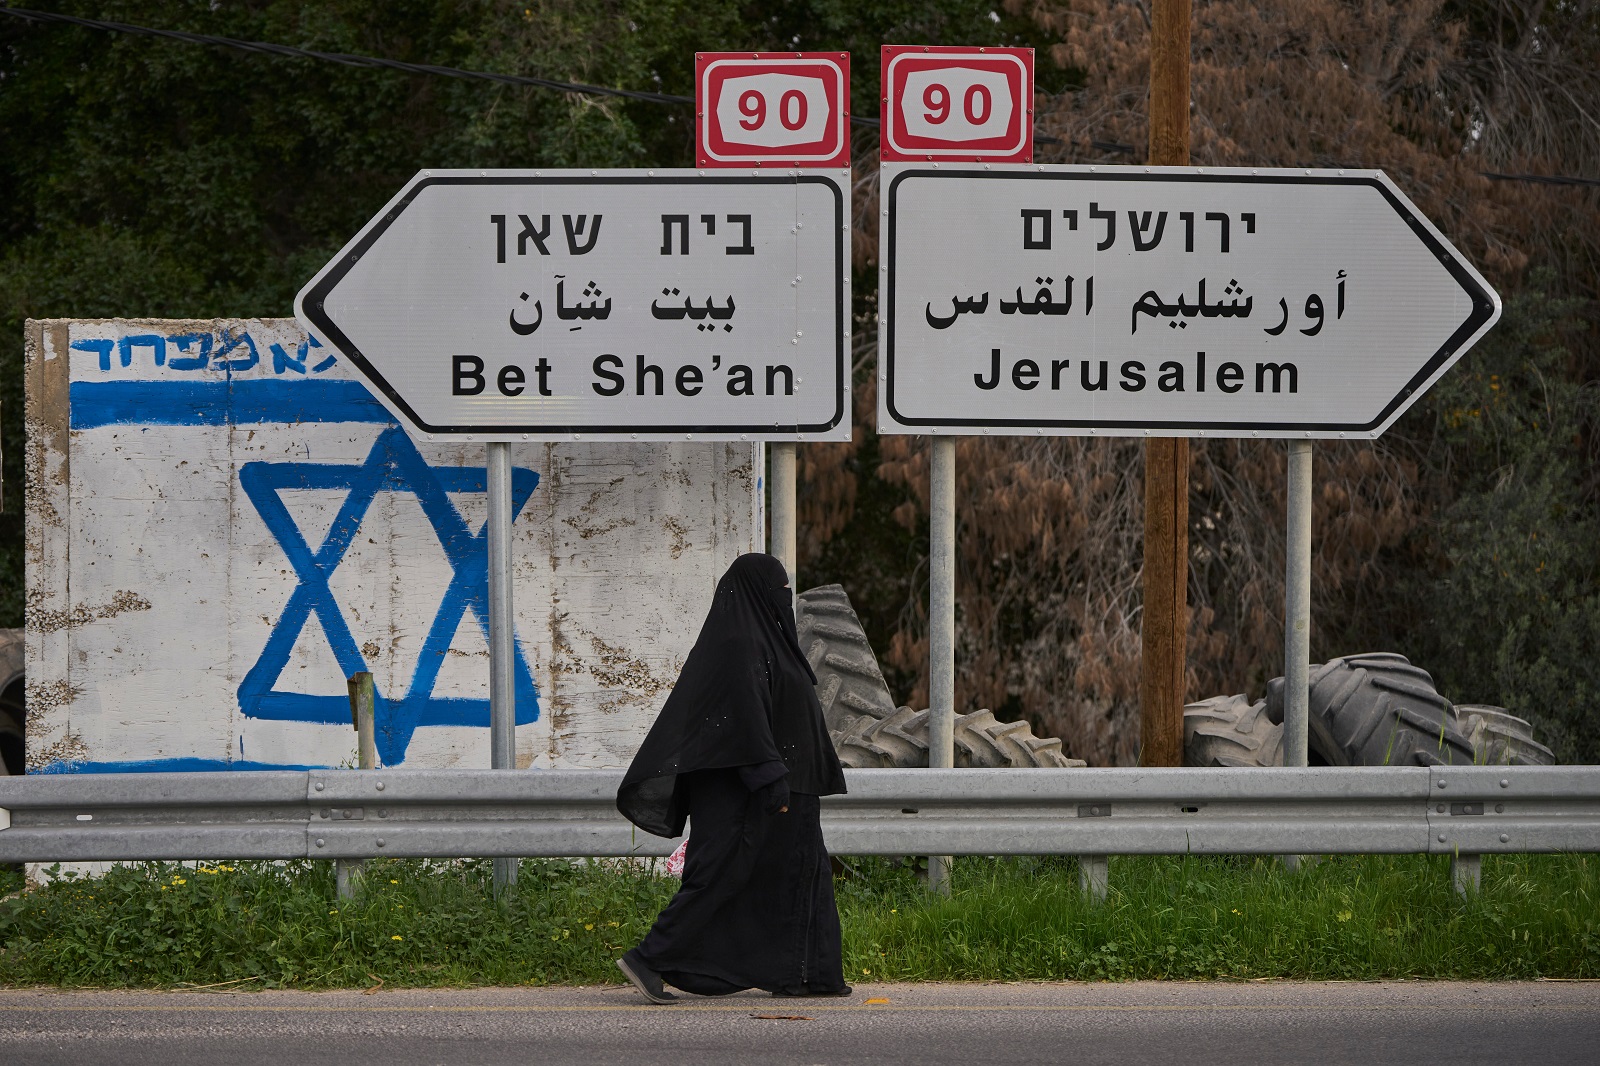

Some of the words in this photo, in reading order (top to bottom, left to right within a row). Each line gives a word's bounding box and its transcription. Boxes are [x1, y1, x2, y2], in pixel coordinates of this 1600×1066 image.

[737, 89, 809, 131] 90
[922, 83, 993, 126] 90
[490, 214, 603, 264] שאן
[660, 214, 755, 256] בית
[1020, 201, 1256, 254] ירושלים
[650, 287, 736, 333] بيت
[925, 274, 1094, 330] القدس
[452, 354, 552, 397] Bet
[973, 348, 1299, 394] Jerusalem
